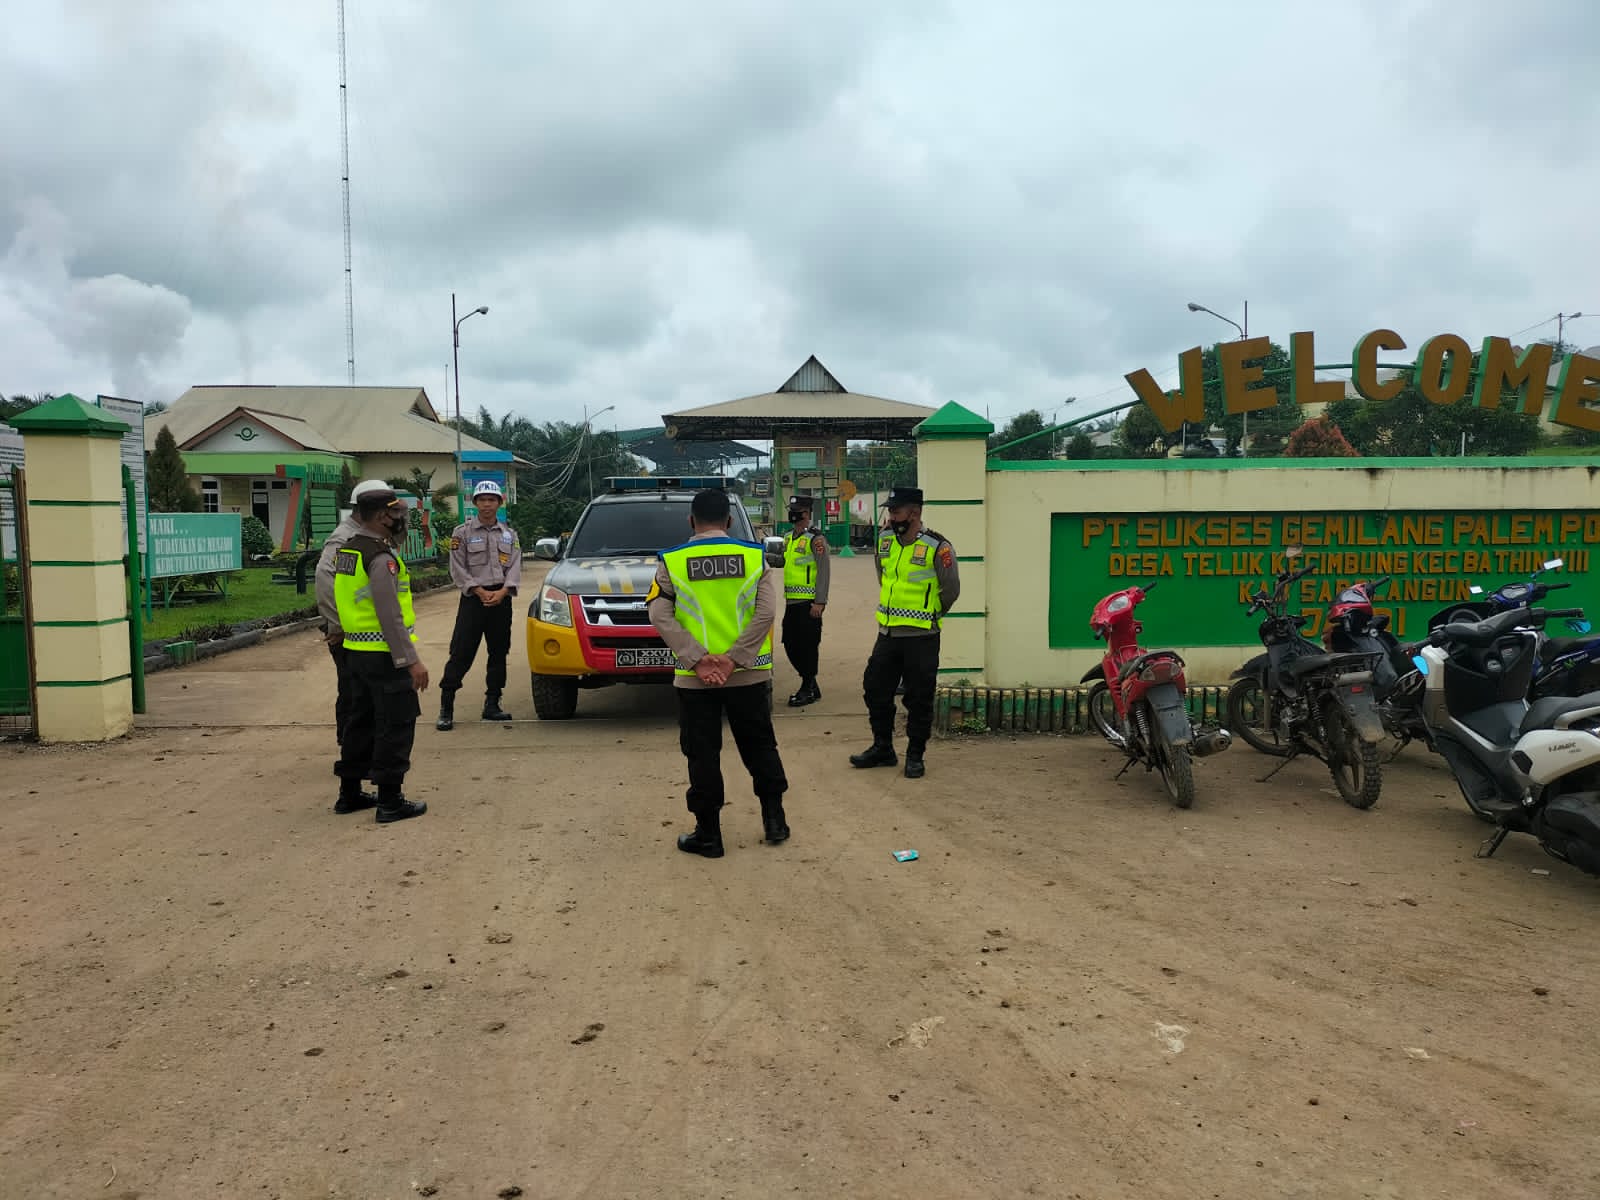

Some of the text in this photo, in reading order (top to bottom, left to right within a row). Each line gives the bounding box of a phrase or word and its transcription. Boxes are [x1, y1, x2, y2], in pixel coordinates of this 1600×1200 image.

[1125, 328, 1600, 433] WELCOME
[1137, 516, 1272, 546] SUKSES
[1282, 515, 1445, 546] GEMILANG
[1453, 514, 1553, 545] PALEM
[690, 557, 742, 577] POLISI
[1110, 553, 1174, 576] DESA
[1184, 552, 1264, 576] TELUK
[1413, 551, 1460, 574] KEC
[1301, 577, 1472, 603] SALANGUN
